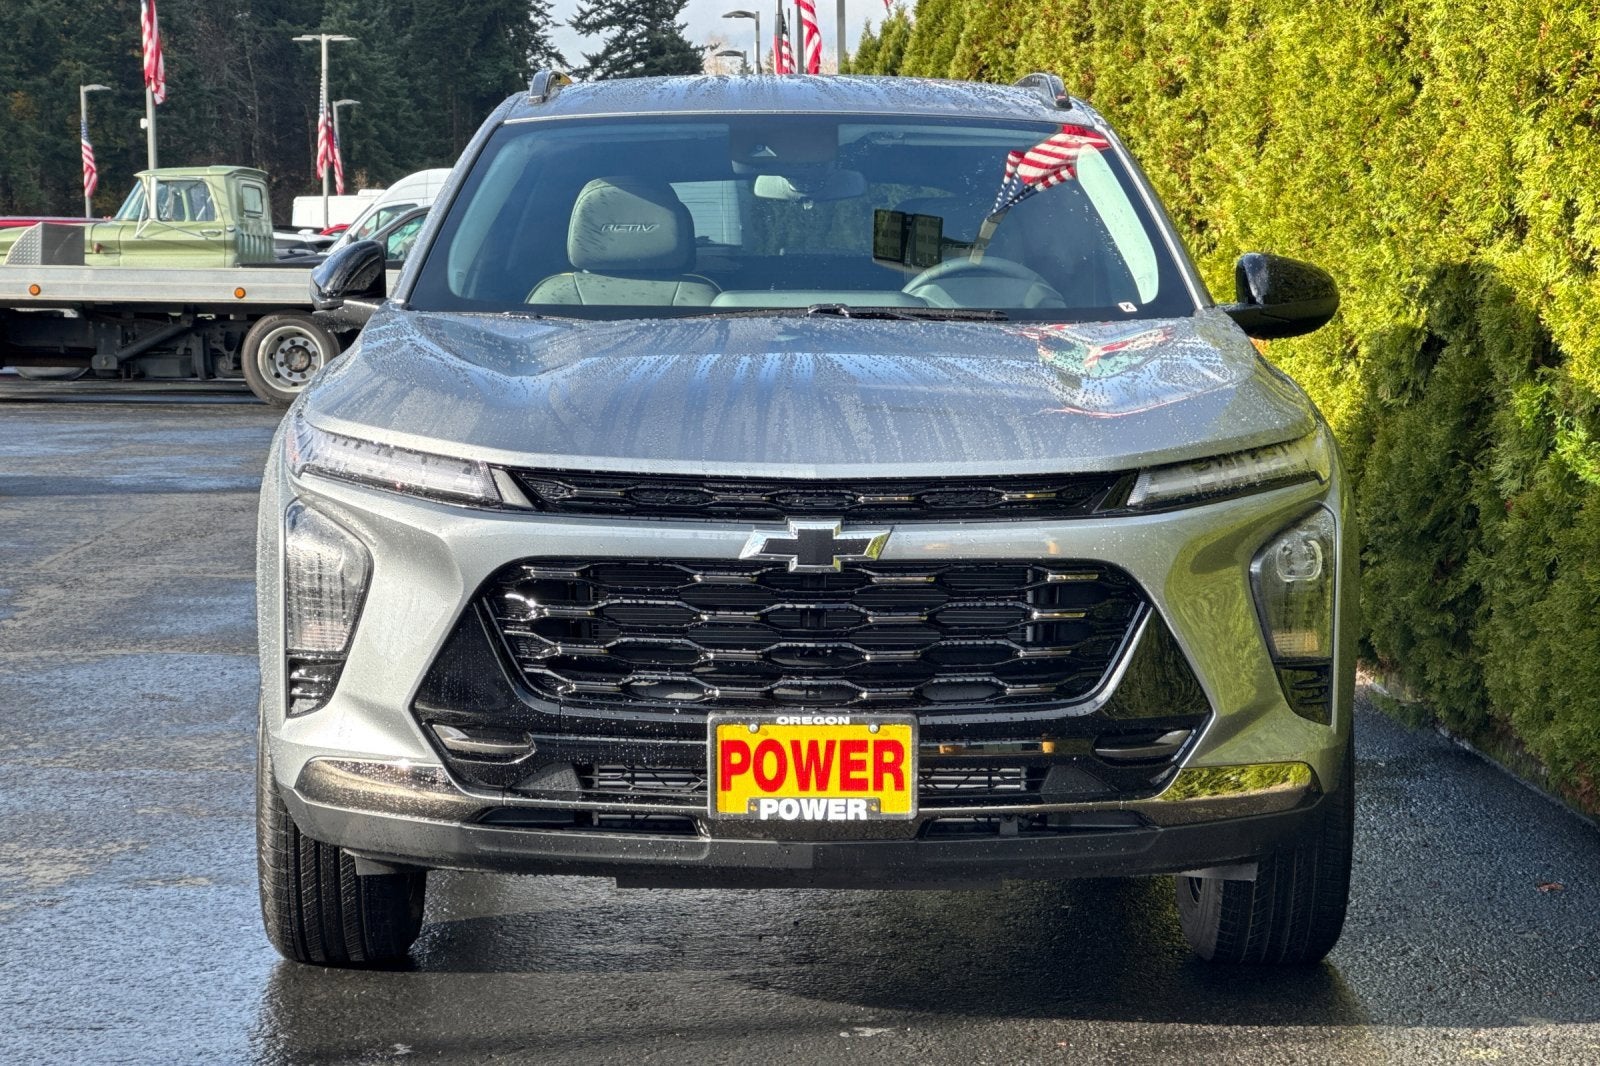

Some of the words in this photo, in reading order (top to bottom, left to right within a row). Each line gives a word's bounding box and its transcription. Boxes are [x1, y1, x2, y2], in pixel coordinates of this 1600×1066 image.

[601, 223, 660, 232] ACTIV
[776, 716, 850, 725] OREGON
[720, 738, 905, 792] POWER
[759, 798, 867, 820] POWER
